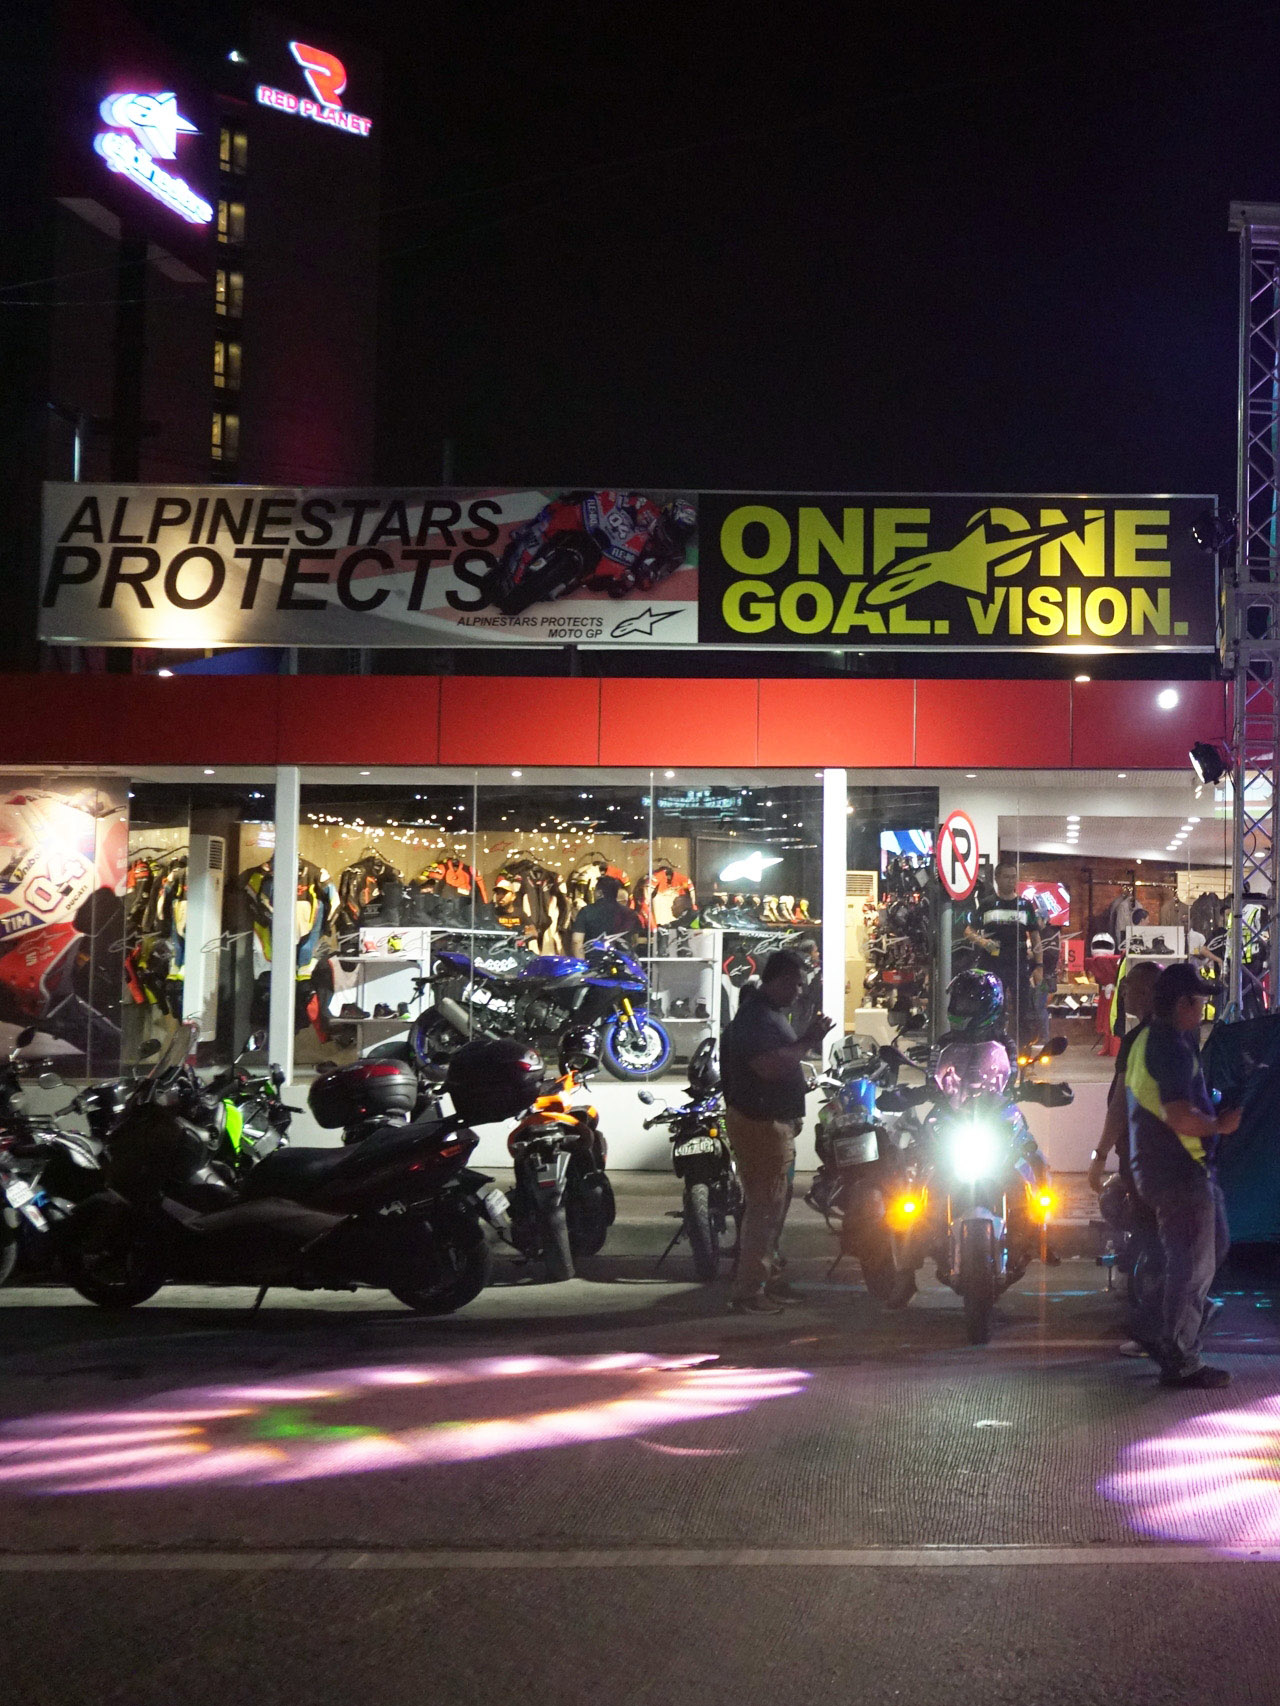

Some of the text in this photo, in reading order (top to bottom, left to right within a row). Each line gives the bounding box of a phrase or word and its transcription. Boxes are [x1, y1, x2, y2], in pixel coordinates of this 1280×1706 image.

[258, 85, 373, 136] RED PLANET
[58, 496, 502, 546] ALPINESTARS
[720, 505, 1171, 577] ONE ONE
[42, 545, 499, 612] PROTECTS
[457, 616, 604, 627] ALPINESTARS PROTECTS
[548, 628, 603, 639] MOTO GP
[966, 587, 1189, 637] VISION.
[1, 912, 32, 934] TIM
